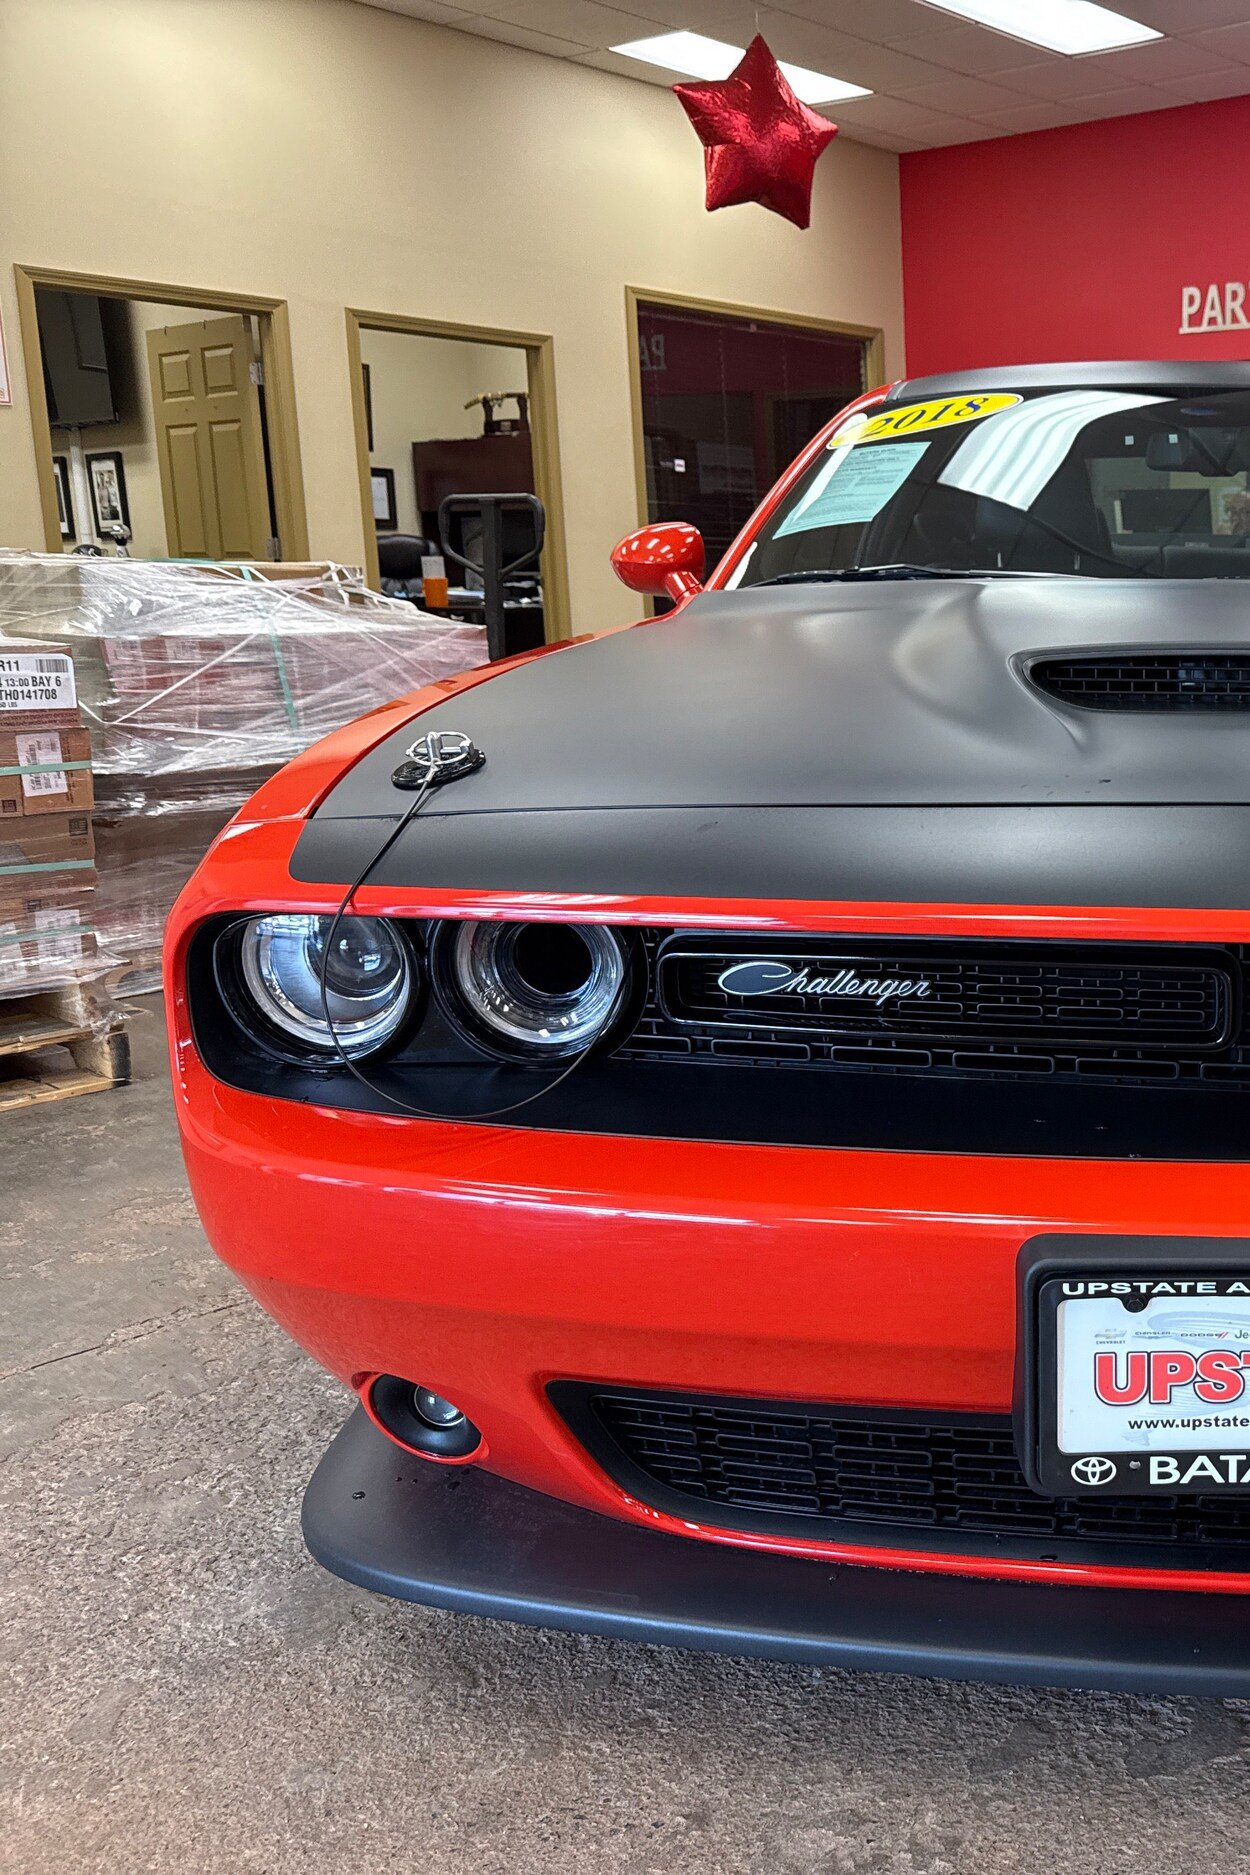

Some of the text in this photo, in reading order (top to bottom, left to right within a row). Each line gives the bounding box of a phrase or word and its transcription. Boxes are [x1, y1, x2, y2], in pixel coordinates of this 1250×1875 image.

[858, 397, 989, 439] 2018
[5, 678, 30, 687] 13:00
[31, 676, 52, 687] BAY
[55, 675, 62, 687] 6
[717, 960, 932, 1007] Challenger
[1062, 1281, 1217, 1295] UPSTATE
